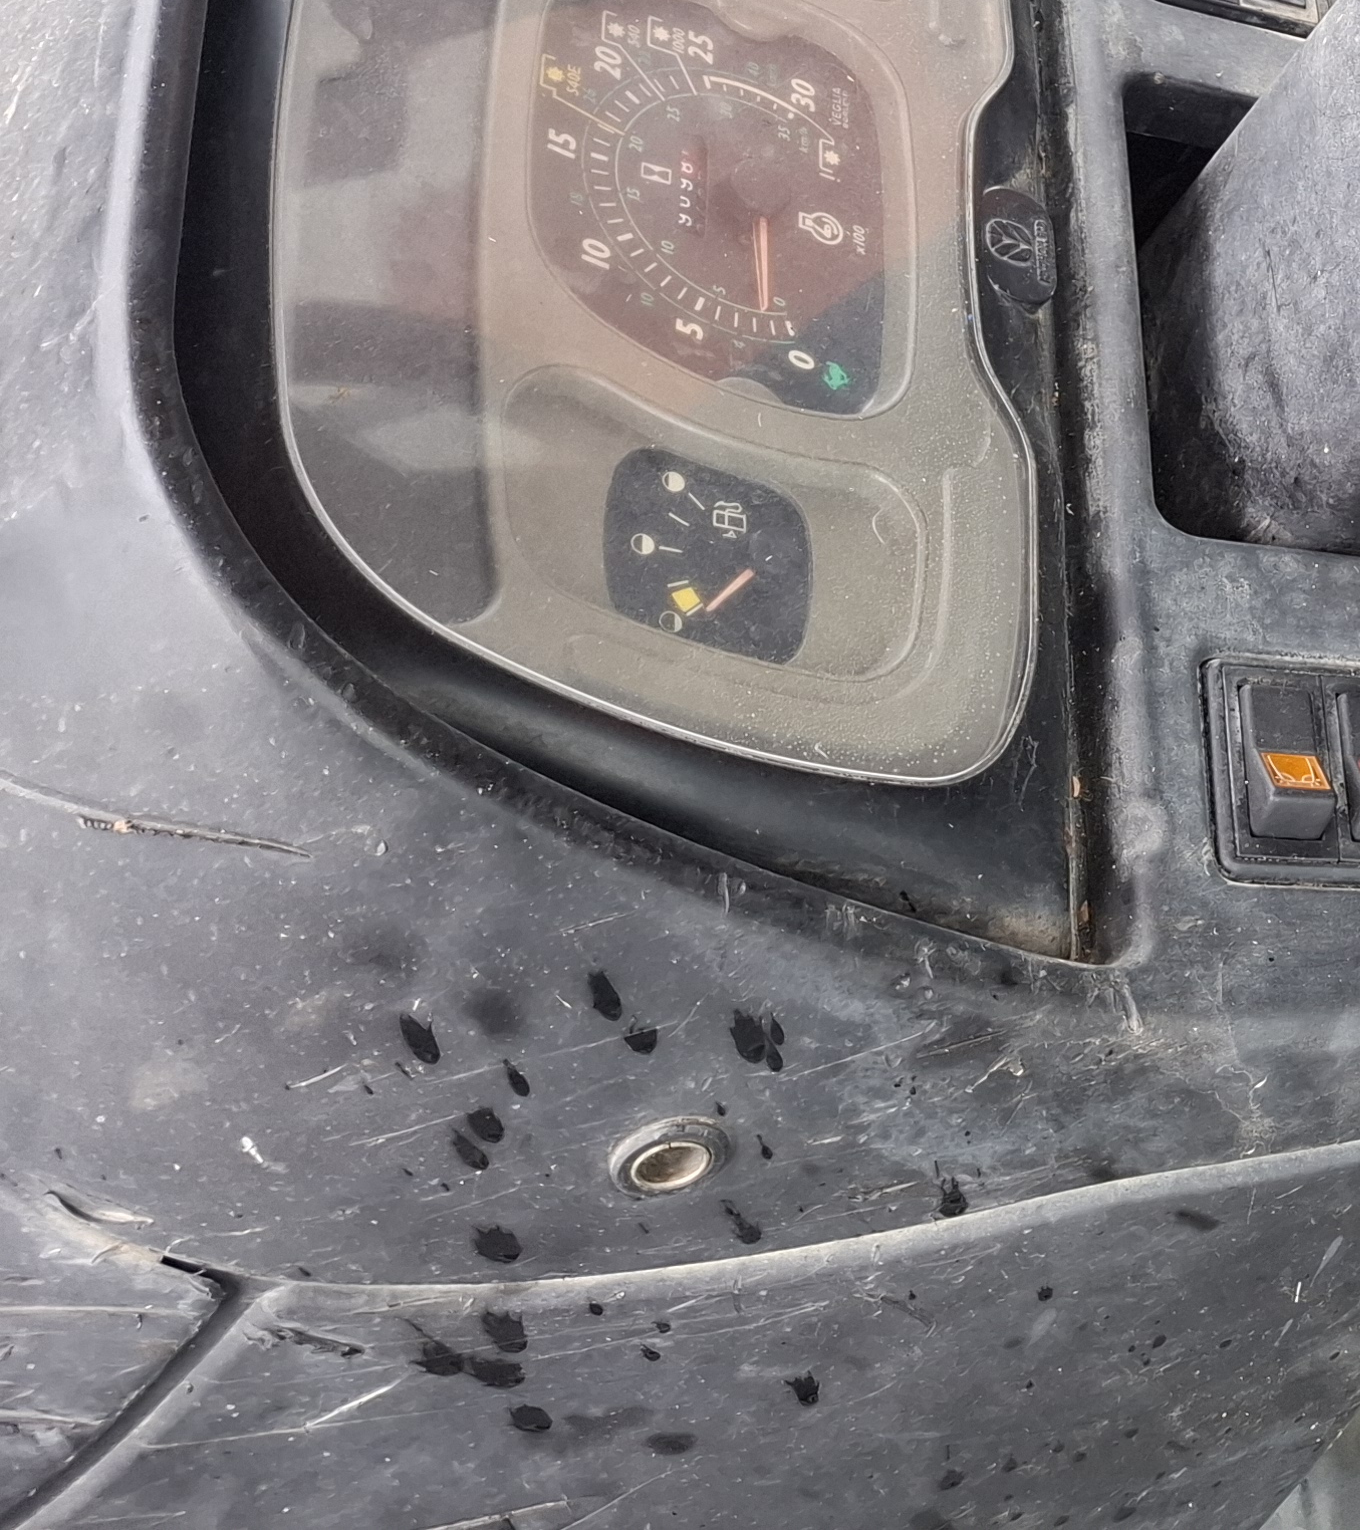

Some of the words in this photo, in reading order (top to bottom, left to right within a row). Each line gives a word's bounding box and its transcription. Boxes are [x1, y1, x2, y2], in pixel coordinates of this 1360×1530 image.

[672, 27, 686, 54] 1000
[687, 30, 714, 65] 25
[593, 45, 623, 81] 20
[566, 64, 582, 96] 540E
[790, 78, 816, 113] 30
[831, 86, 843, 127] VEGLIA
[665, 105, 681, 123] 25
[546, 127, 577, 160] 15
[628, 135, 644, 153] 20
[777, 124, 792, 142] 35
[626, 186, 641, 201] 15
[660, 239, 675, 255] 10
[852, 224, 866, 256] x100
[580, 238, 612, 270] 10
[640, 292, 655, 307] 10
[712, 284, 727, 296] 5
[674, 317, 704, 341] 5
[788, 349, 815, 370] 0
